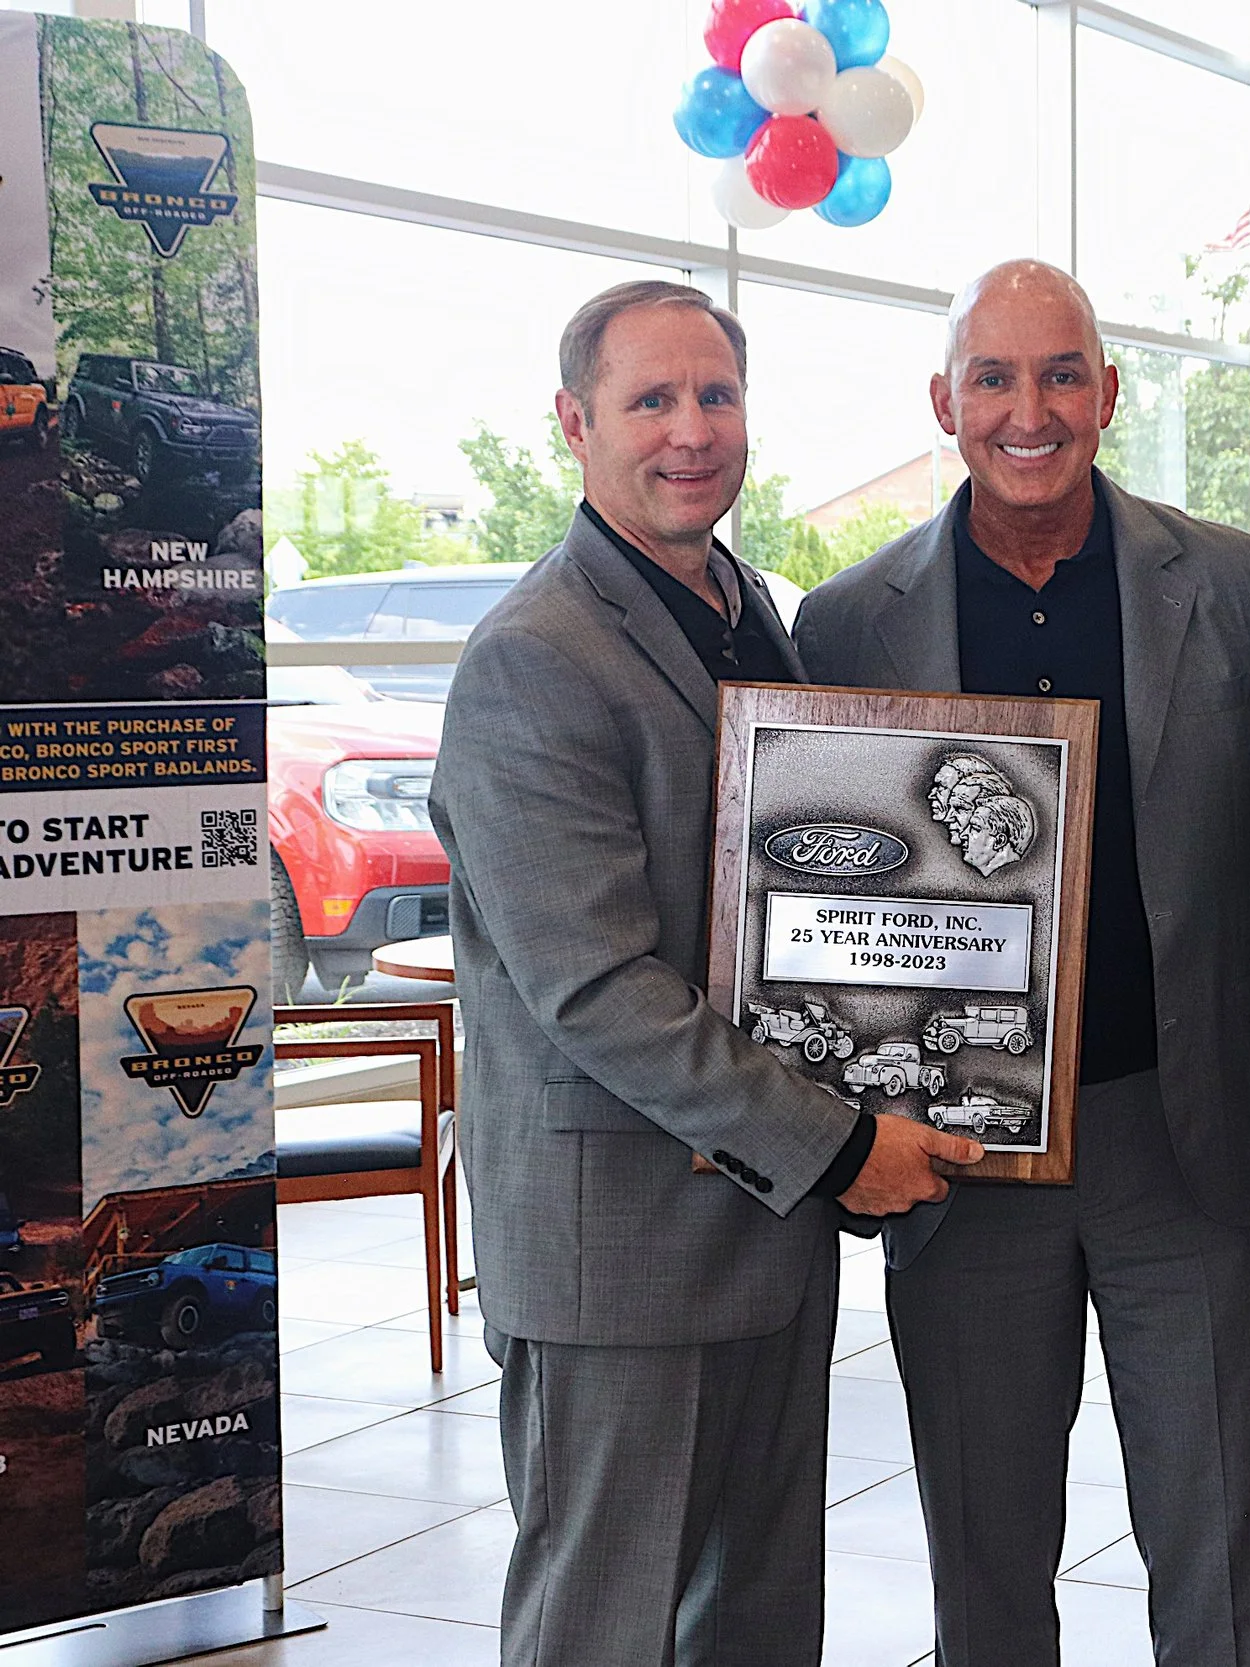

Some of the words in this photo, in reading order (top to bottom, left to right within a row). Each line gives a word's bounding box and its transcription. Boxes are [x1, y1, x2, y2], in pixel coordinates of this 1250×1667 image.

[99, 189, 227, 210] BRONCO
[151, 541, 208, 562] NEW
[103, 568, 256, 589] HAMPSHIRE
[7, 722, 57, 737] WITH
[63, 721, 101, 736] THE
[107, 719, 206, 734] PURCHASE
[212, 718, 236, 732] OF
[36, 742, 115, 758] BRONCO
[120, 740, 180, 755] SPORT
[186, 738, 238, 753] FIRST
[1, 764, 81, 781] BRONCO
[87, 762, 148, 778] SPORT
[154, 759, 257, 776] BADLANDS.
[43, 814, 149, 842] START
[791, 829, 879, 868] Ford
[815, 909, 875, 926] SPIRIT
[881, 912, 938, 931] FORD,
[945, 916, 982, 931] INC.
[790, 928, 813, 943] 25
[820, 929, 869, 946] YEAR
[875, 932, 1007, 953] ANNIVERSARY
[849, 951, 946, 970] 1998-2023
[131, 1051, 253, 1072] BRONCO
[146, 1412, 249, 1448] NEVADA
